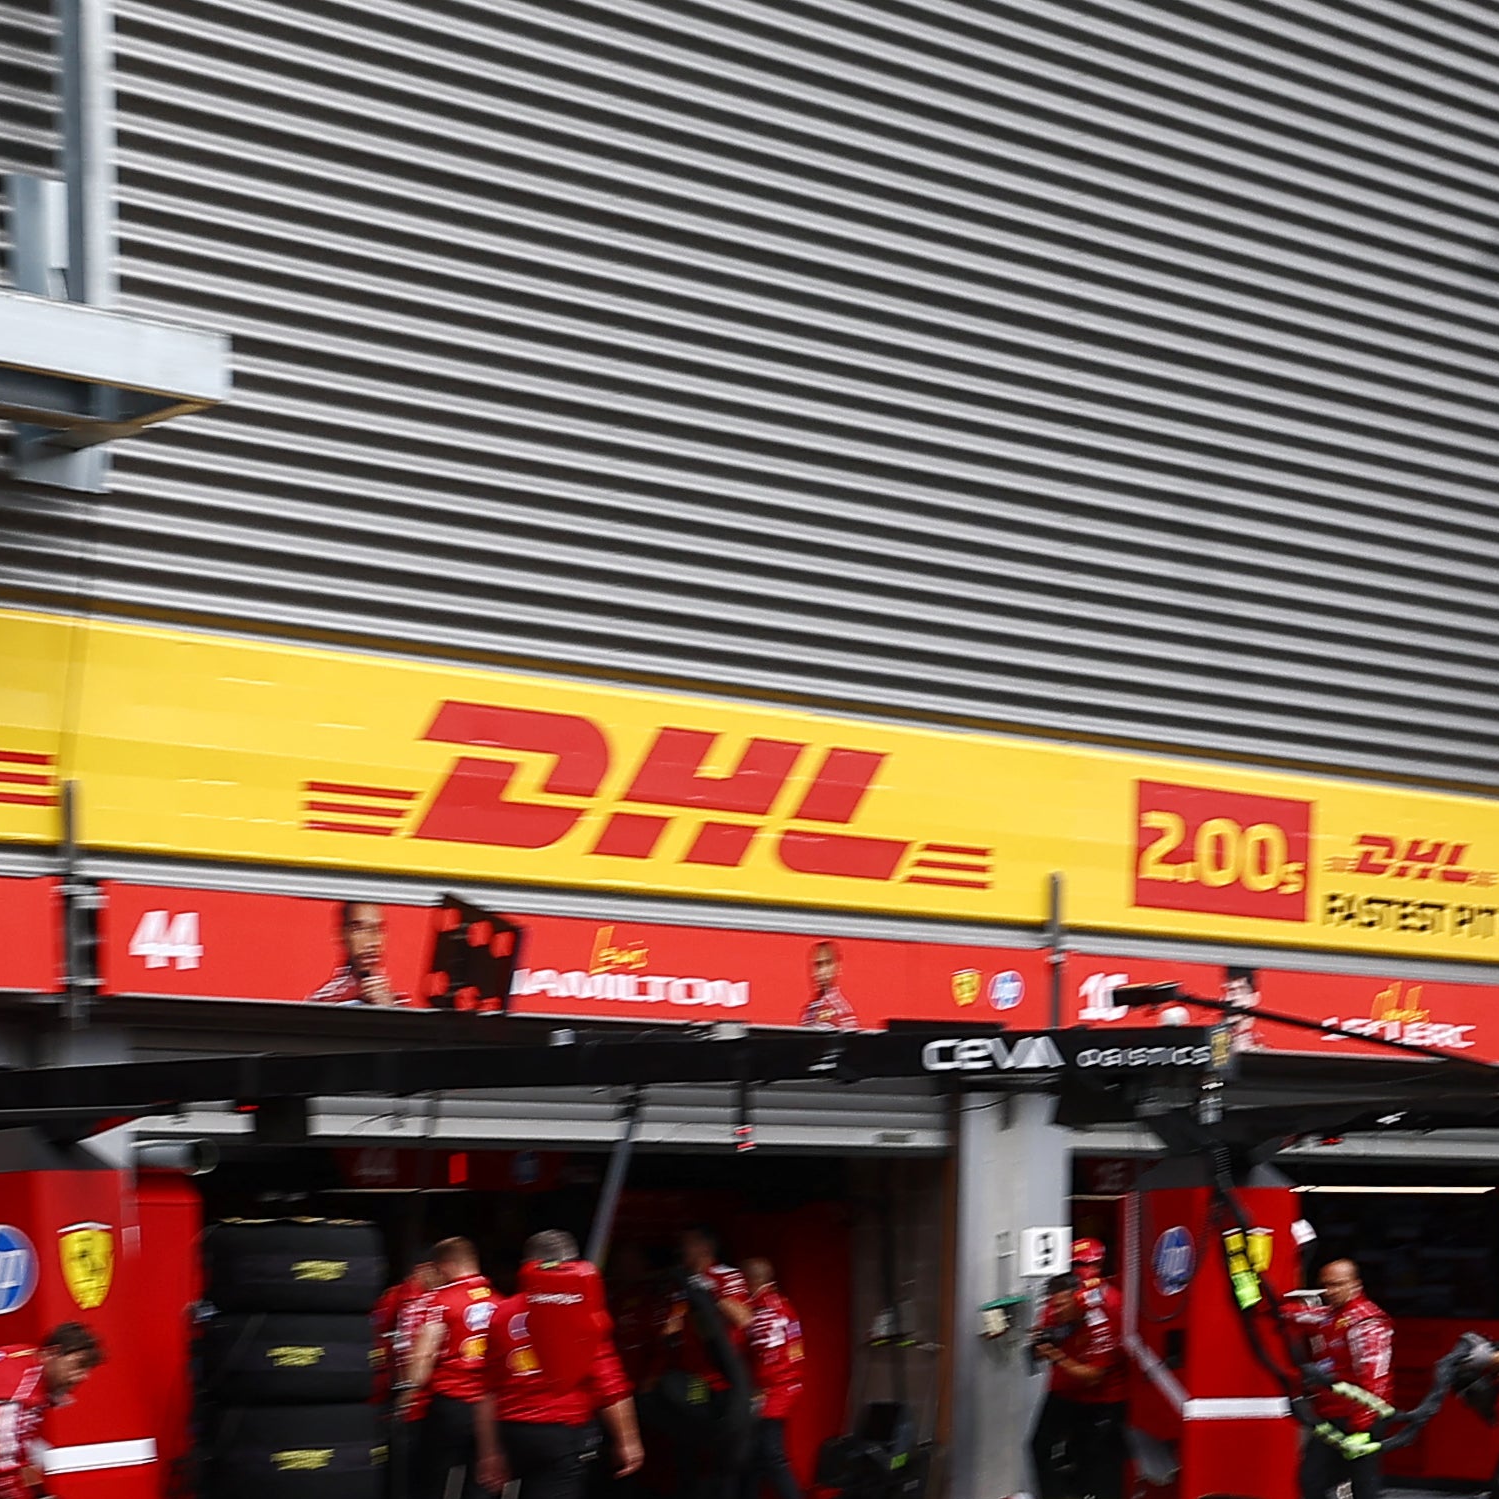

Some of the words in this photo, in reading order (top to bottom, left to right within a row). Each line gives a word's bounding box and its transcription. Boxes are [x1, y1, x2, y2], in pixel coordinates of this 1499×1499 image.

[410, 699, 914, 882] DHL
[1138, 808, 1306, 896] 2.00s
[1351, 833, 1476, 886] DHL
[128, 909, 204, 971] 44
[1323, 891, 1450, 934] FASTEST
[1454, 904, 1497, 939] PIT
[921, 1036, 1066, 1071] CEVA
